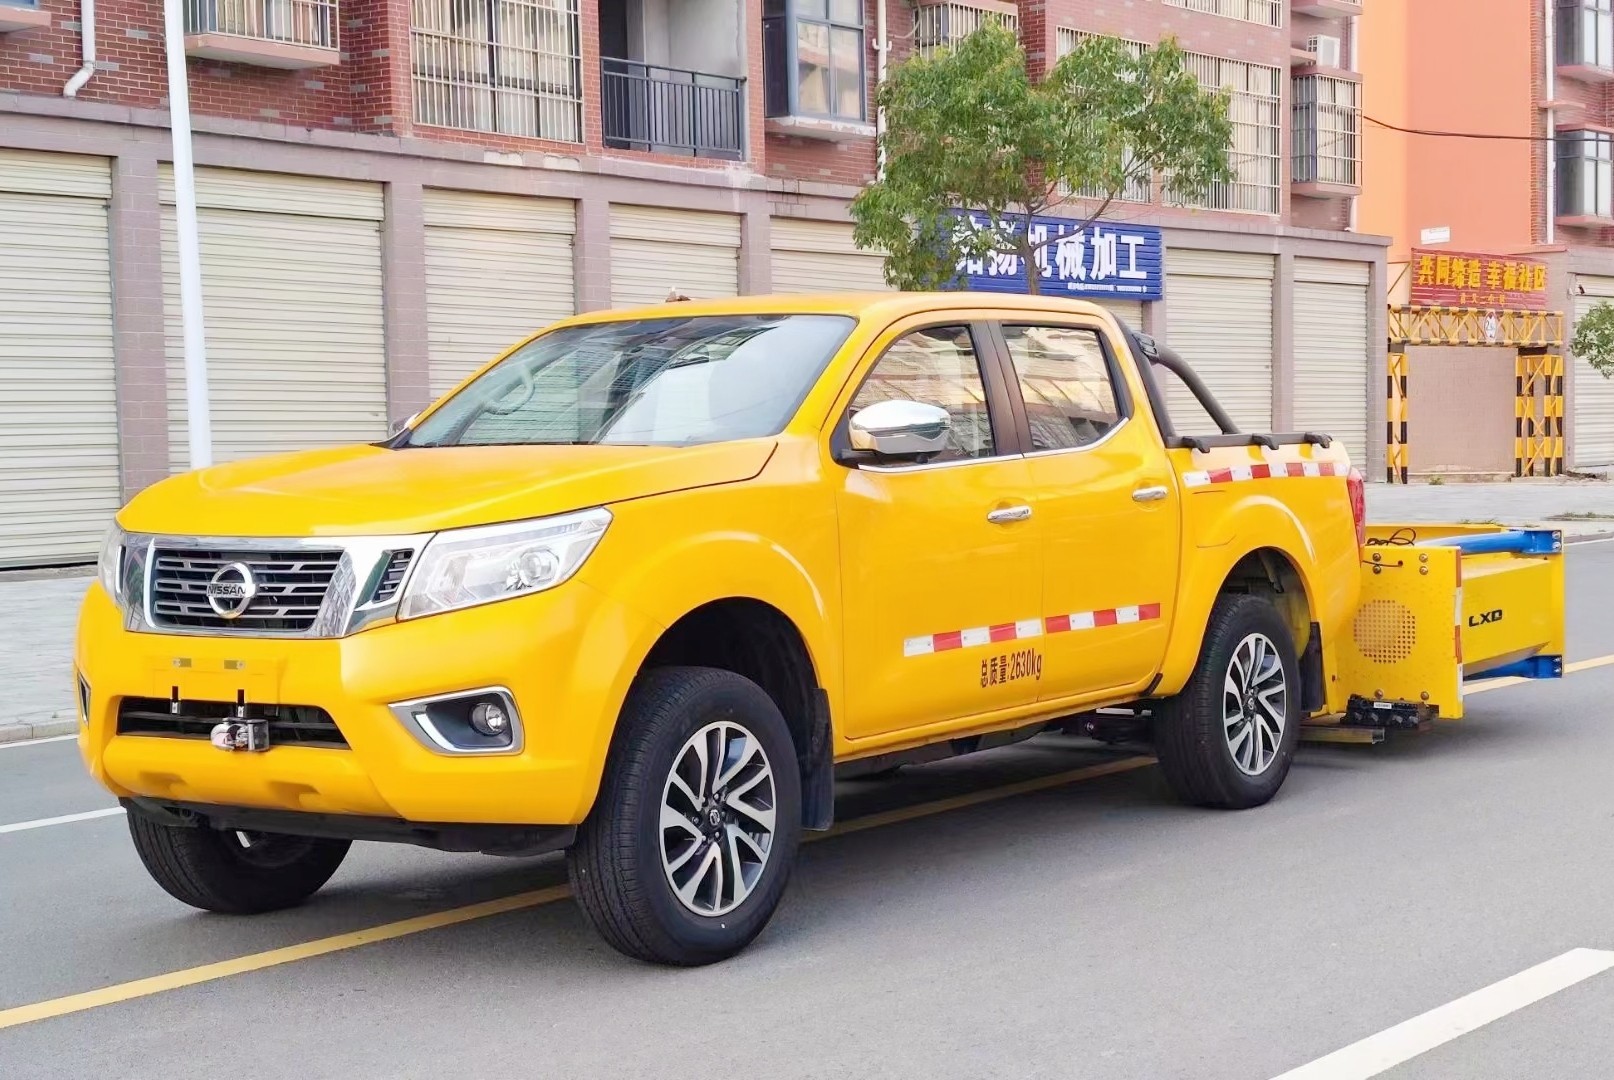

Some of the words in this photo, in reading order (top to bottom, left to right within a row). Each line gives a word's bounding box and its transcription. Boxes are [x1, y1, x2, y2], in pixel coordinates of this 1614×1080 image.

[1486, 260, 1547, 292] 幸福社区
[207, 586, 246, 596] NISSAN
